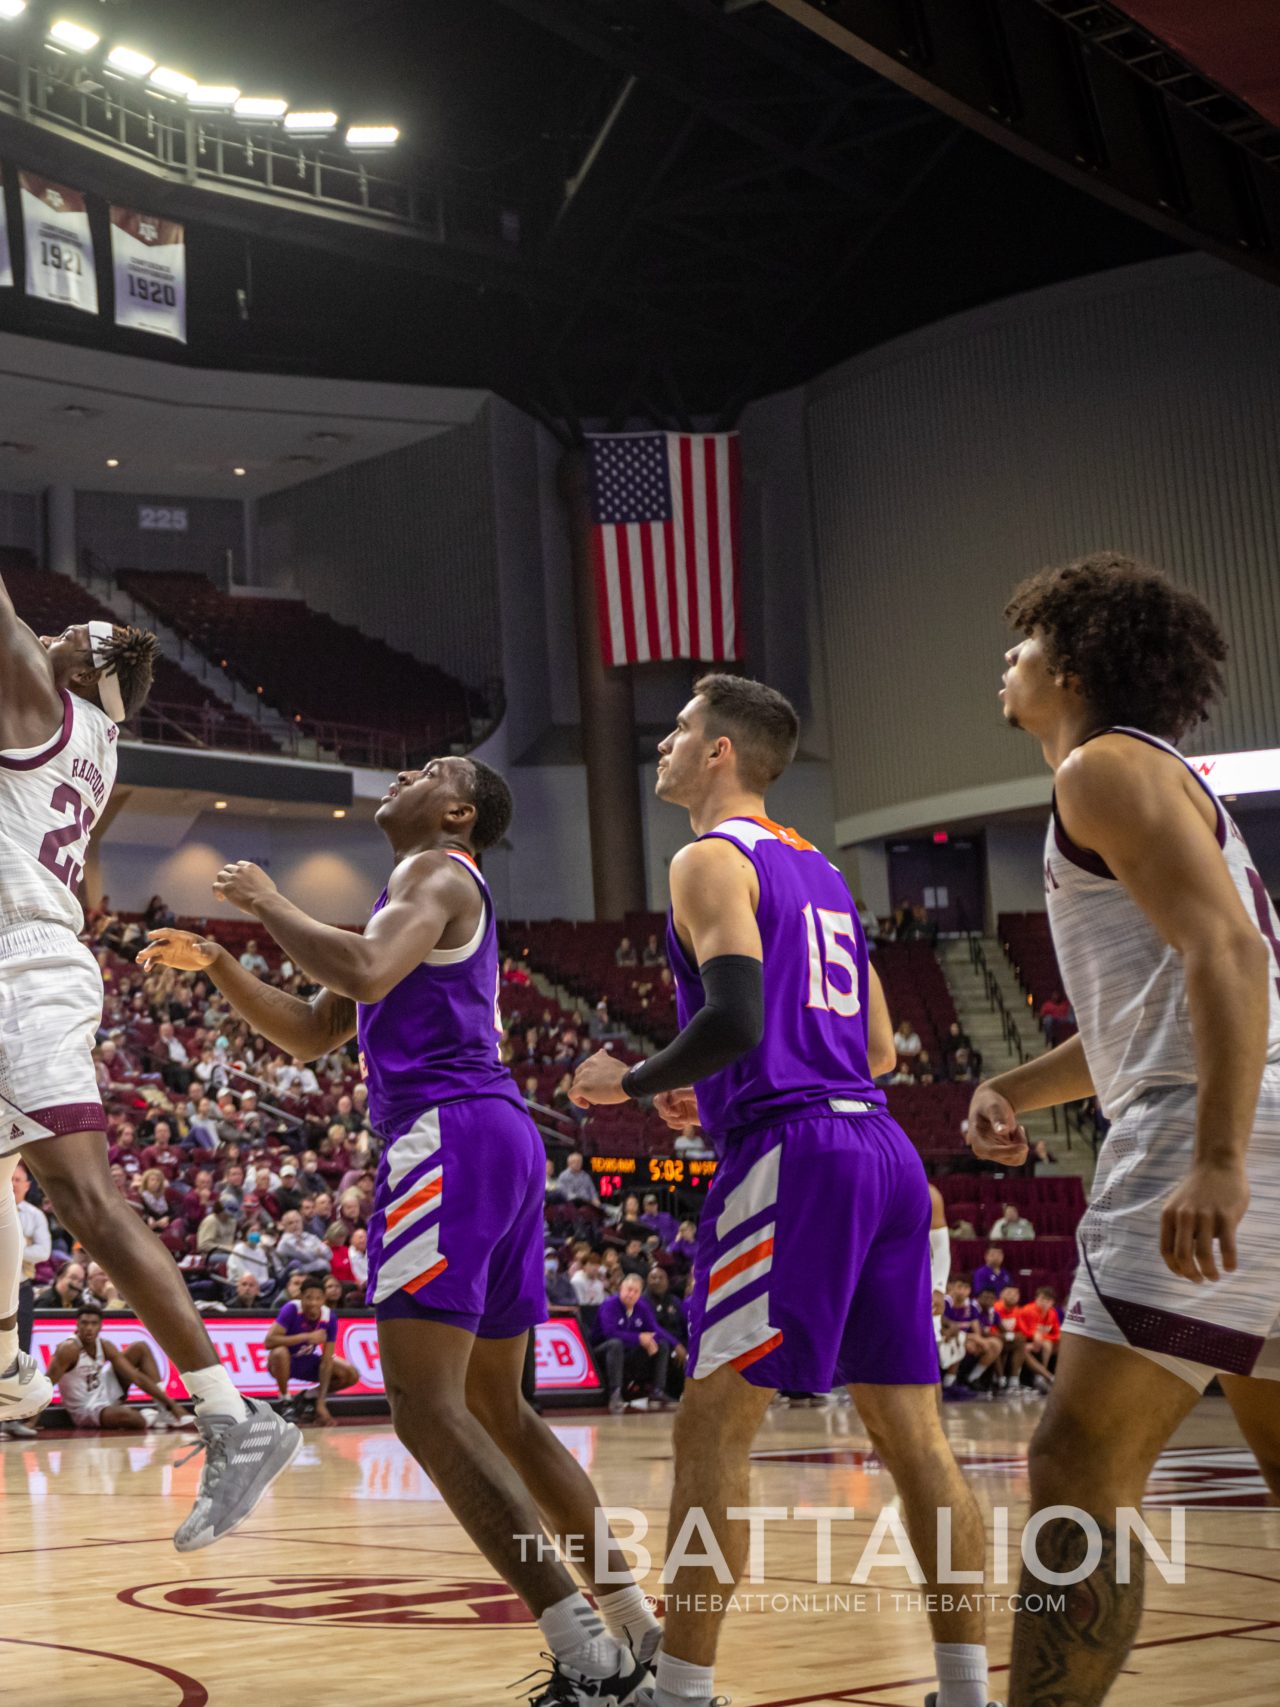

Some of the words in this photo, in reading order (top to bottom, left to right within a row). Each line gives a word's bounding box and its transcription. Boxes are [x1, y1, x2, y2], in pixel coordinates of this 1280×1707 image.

[41, 240, 83, 277] 1921
[127, 273, 177, 308] 1920
[140, 508, 187, 530] 225
[801, 901, 861, 1017] 15
